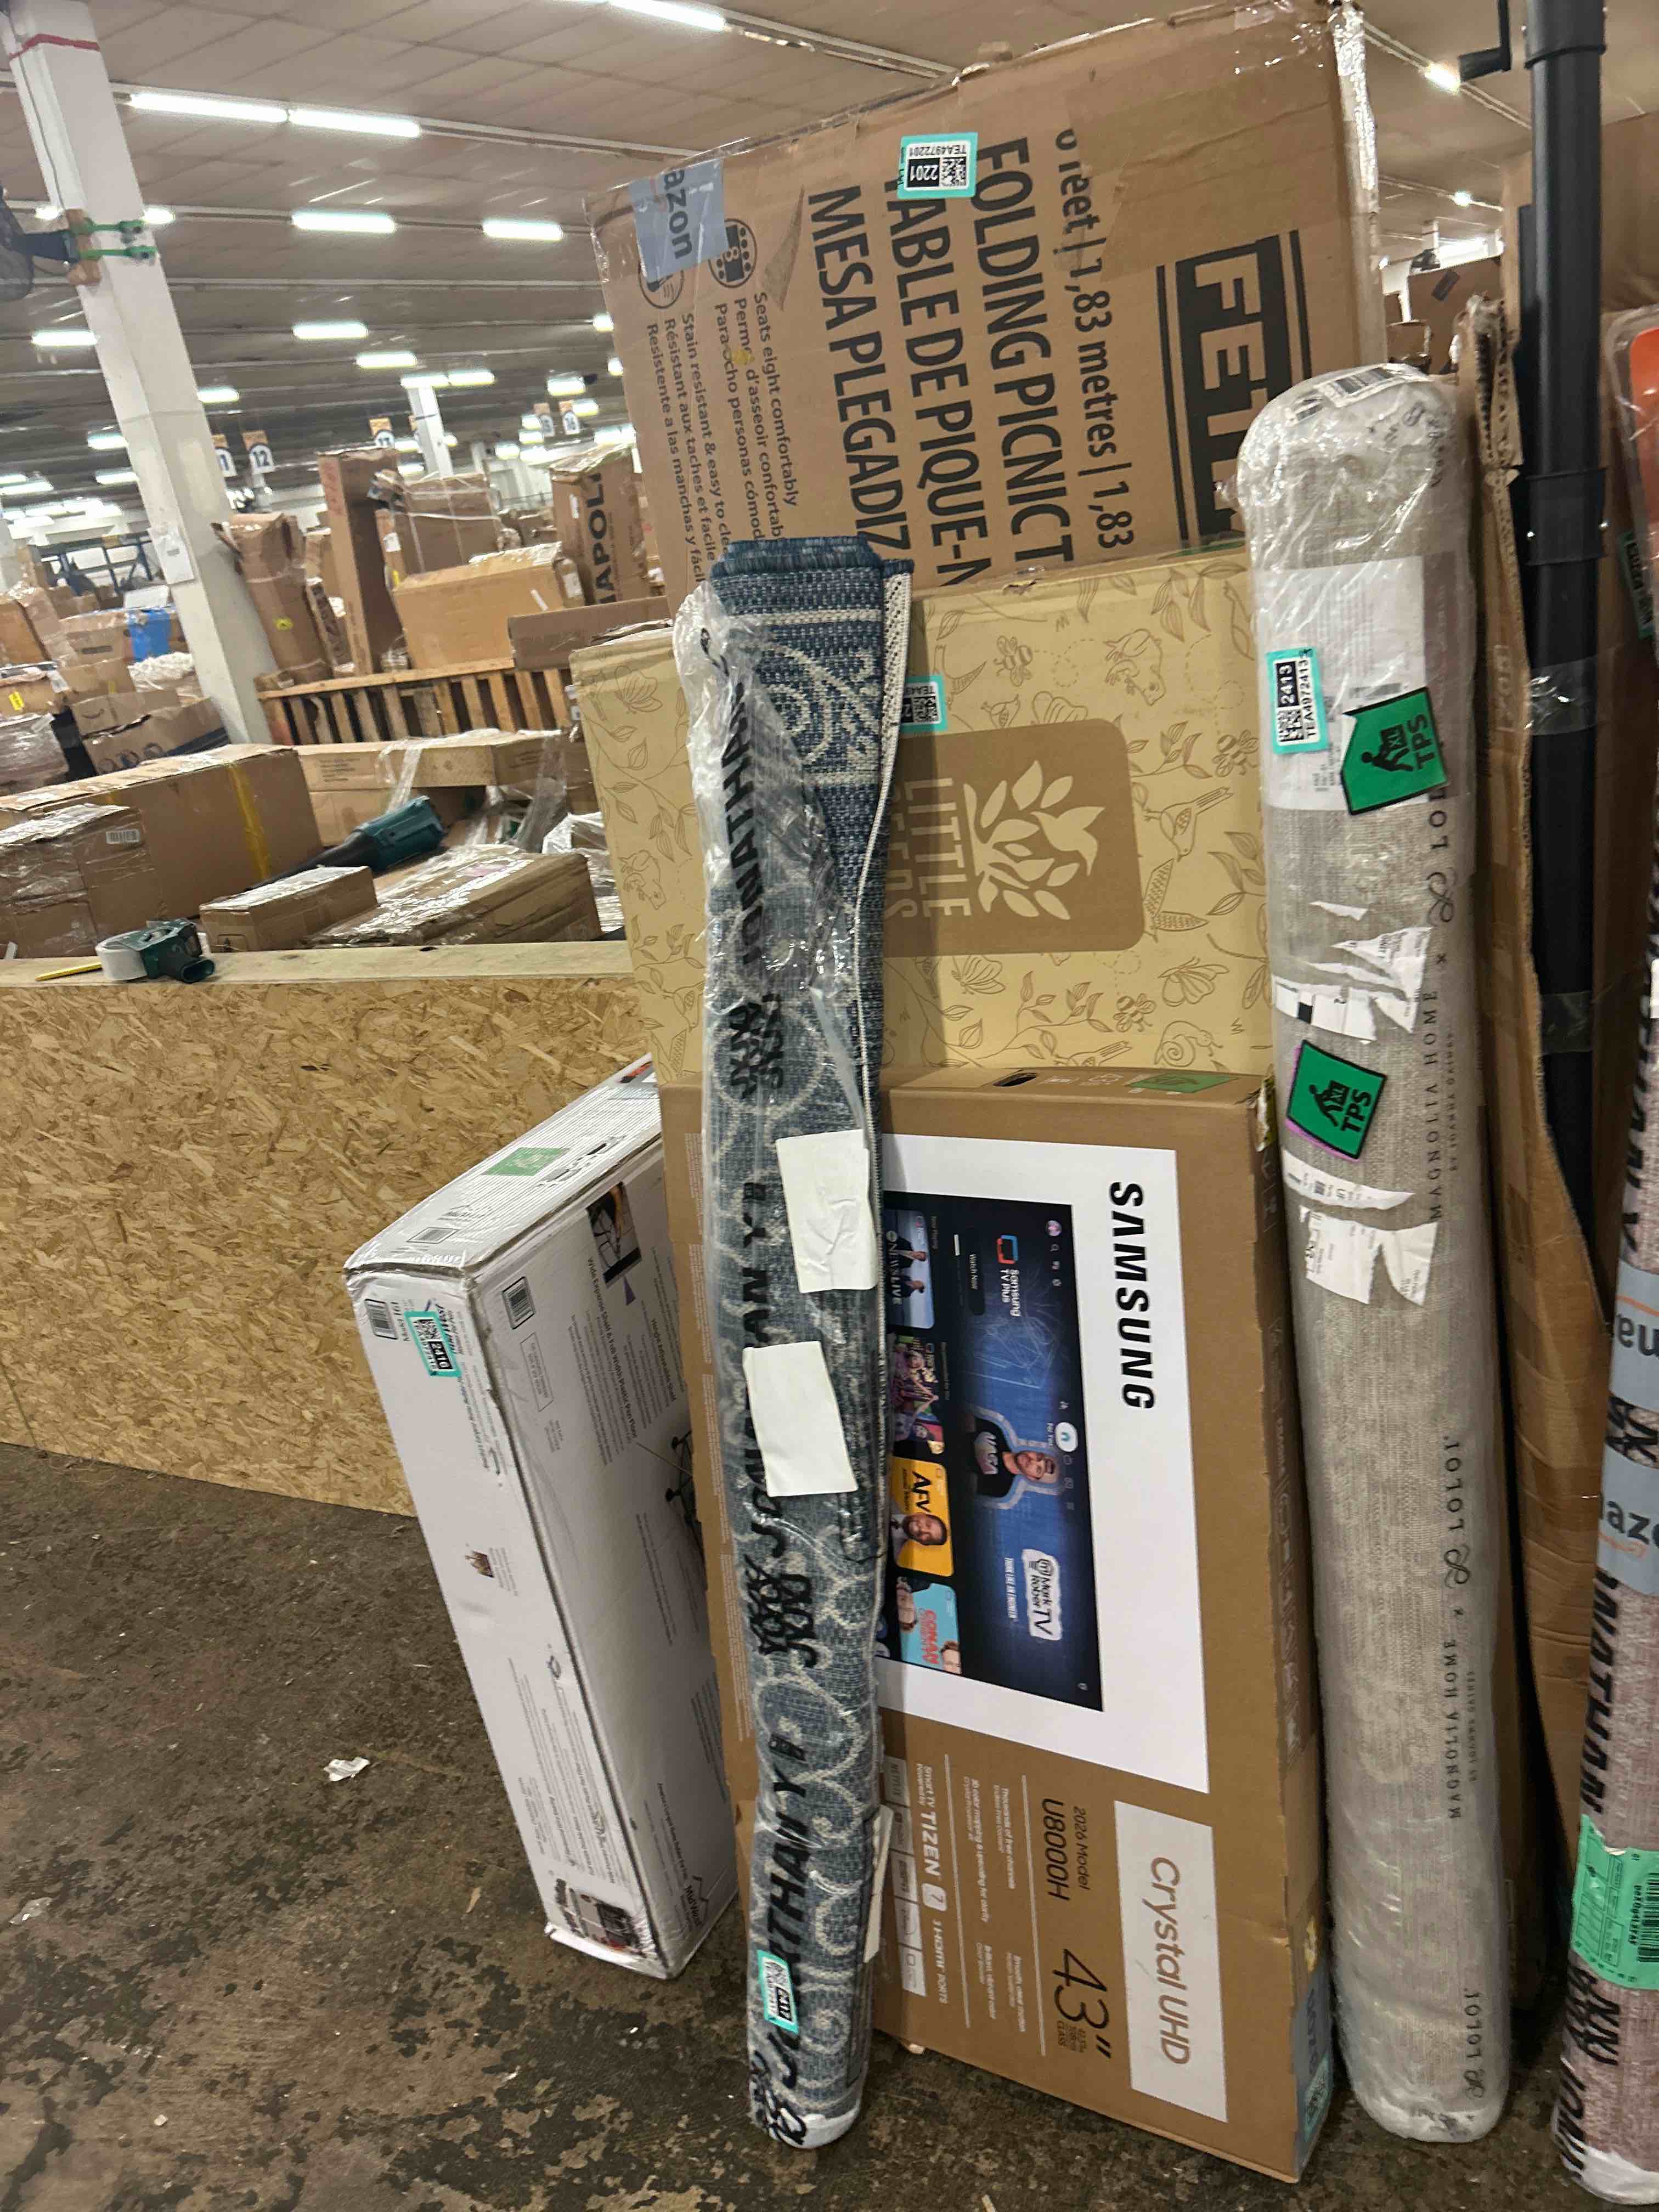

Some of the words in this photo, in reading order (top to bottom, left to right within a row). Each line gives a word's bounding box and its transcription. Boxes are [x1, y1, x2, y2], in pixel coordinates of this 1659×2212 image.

[909, 164, 938, 181] 2201
[806, 185, 878, 330] MESA
[882, 171, 960, 326] ABLE
[972, 137, 1051, 368] FOLDING
[680, 313, 701, 360] Stain
[752, 291, 774, 343] Seats
[645, 323, 674, 412] Resistente
[663, 317, 691, 397] Résistant
[757, 345, 782, 396] eight
[902, 328, 969, 397] DE
[690, 362, 715, 439] resistant
[713, 302, 732, 345] Para
[726, 397, 754, 477] personas
[1075, 340, 1124, 459] metres
[663, 415, 674, 427] a
[678, 398, 695, 434] aux
[252, 448, 271, 468] 12
[665, 429, 682, 455] las
[685, 436, 706, 492] taches
[703, 442, 718, 456] &
[768, 397, 802, 507] comfortably
[992, 373, 1070, 536] PICNIC
[670, 457, 696, 533] manchas
[702, 458, 723, 498] easy
[695, 495, 709, 514] et
[713, 500, 727, 518] to
[1084, 481, 1135, 551] 1,83
[682, 535, 696, 547] y
[699, 516, 718, 562] facile
[1279, 664, 1295, 704] 2413
[1407, 714, 1434, 770] TPS
[904, 777, 971, 917] LITTLE
[1424, 989, 1437, 1066] HOME
[1339, 1087, 1373, 1136] TPS
[1426, 1082, 1442, 1221] MAGNOLIA
[967, 1252, 978, 1273] Watch
[969, 1274, 979, 1290] Now
[999, 1269, 1008, 1280] TV
[890, 1276, 902, 1305] LIVE
[1001, 1283, 1010, 1303] Plus
[1008, 1268, 1022, 1318] Samsung
[1109, 1182, 1156, 1410] SAMSUNG
[912, 1469, 932, 1514] AFV
[1443, 1441, 1464, 1531] LOLOI
[1029, 1574, 1042, 1609] Rober
[1040, 1576, 1053, 1606] Mark
[923, 1609, 941, 1666] CONAN
[1032, 1607, 1054, 1637] TV
[1442, 1638, 1458, 1697] HOME
[922, 1765, 934, 1794] Smart
[1444, 1711, 1462, 1818] MAGNOLIA
[924, 1794, 934, 1808] TV
[1073, 1805, 1087, 1840] 2026
[919, 1810, 941, 1877] TIZEN
[1040, 1796, 1071, 1903] U8000H
[1074, 1842, 1092, 1892] Model
[1142, 1857, 1185, 1994] Crystal
[936, 1973, 948, 2004] PORTS
[1052, 1949, 1111, 2059] 43"
[1055, 2019, 1066, 2047] CLASS
[1161, 1995, 1190, 2064] UHD
[1464, 1992, 1482, 2058] LOLOI
